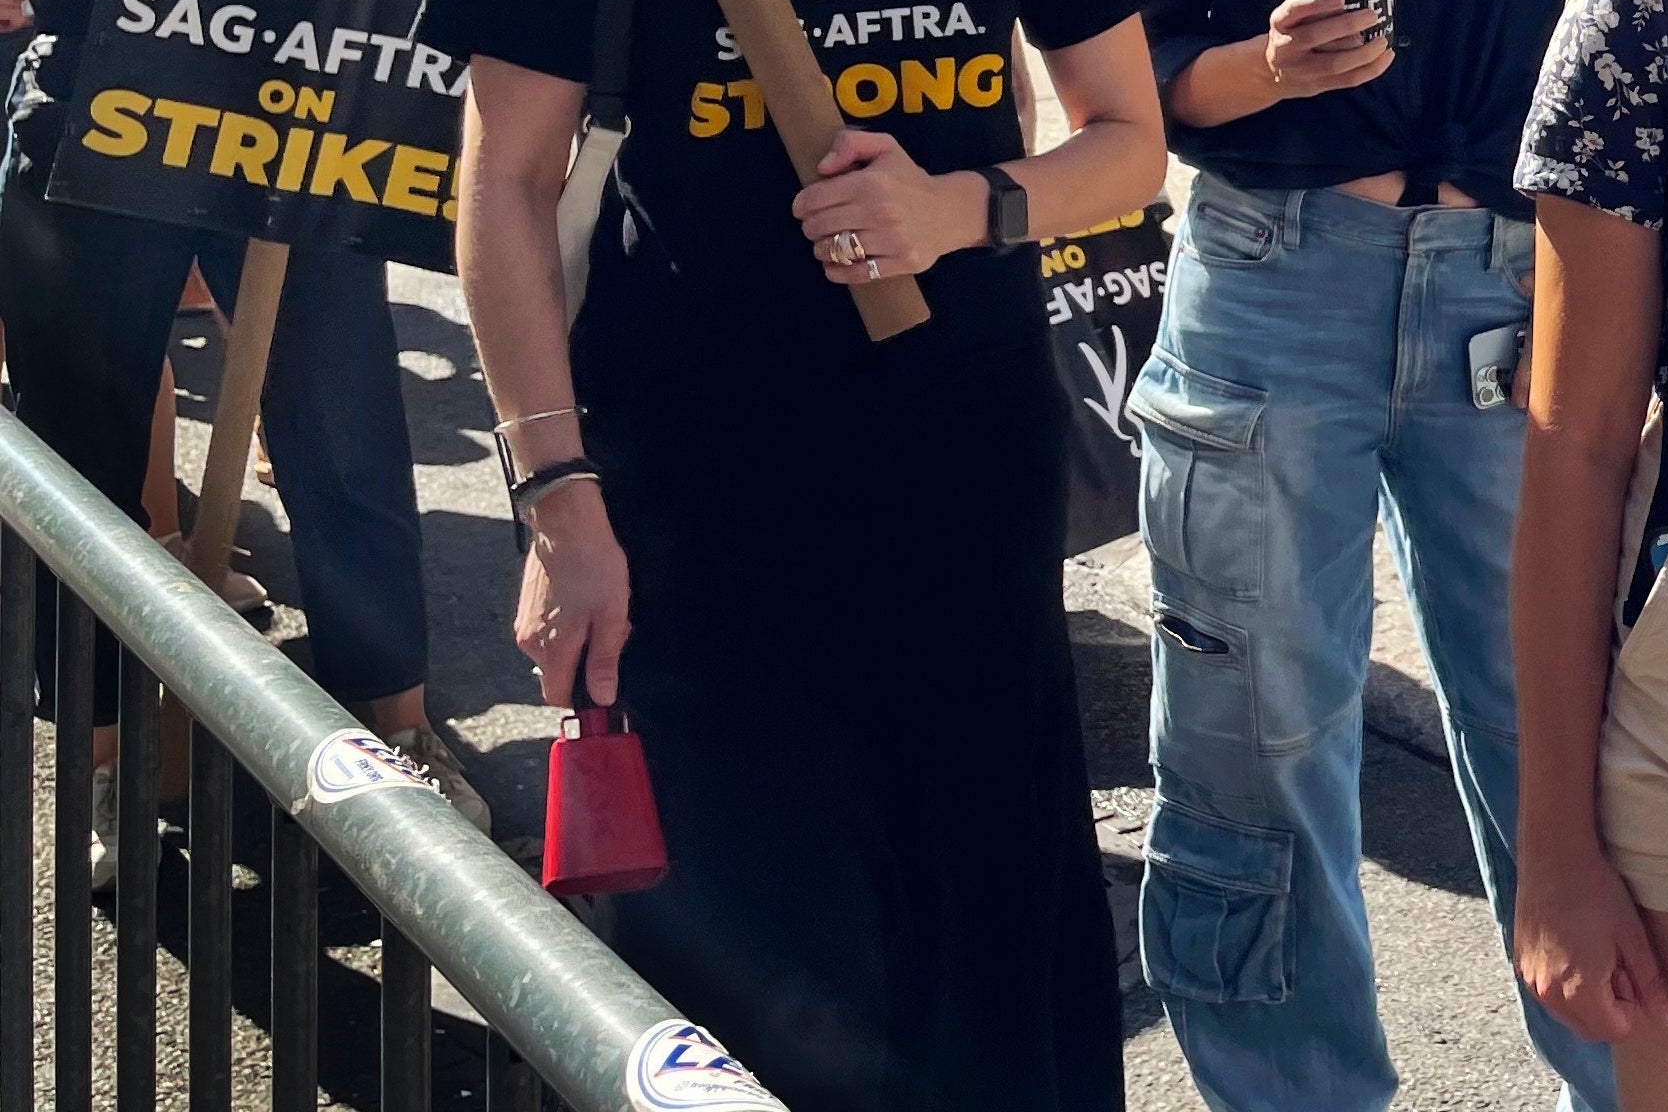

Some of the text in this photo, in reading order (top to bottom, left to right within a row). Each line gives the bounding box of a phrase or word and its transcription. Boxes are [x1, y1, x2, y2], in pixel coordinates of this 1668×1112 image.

[258, 79, 335, 123] ON
[689, 53, 1004, 137] STONG
[1041, 244, 1087, 278] ON
